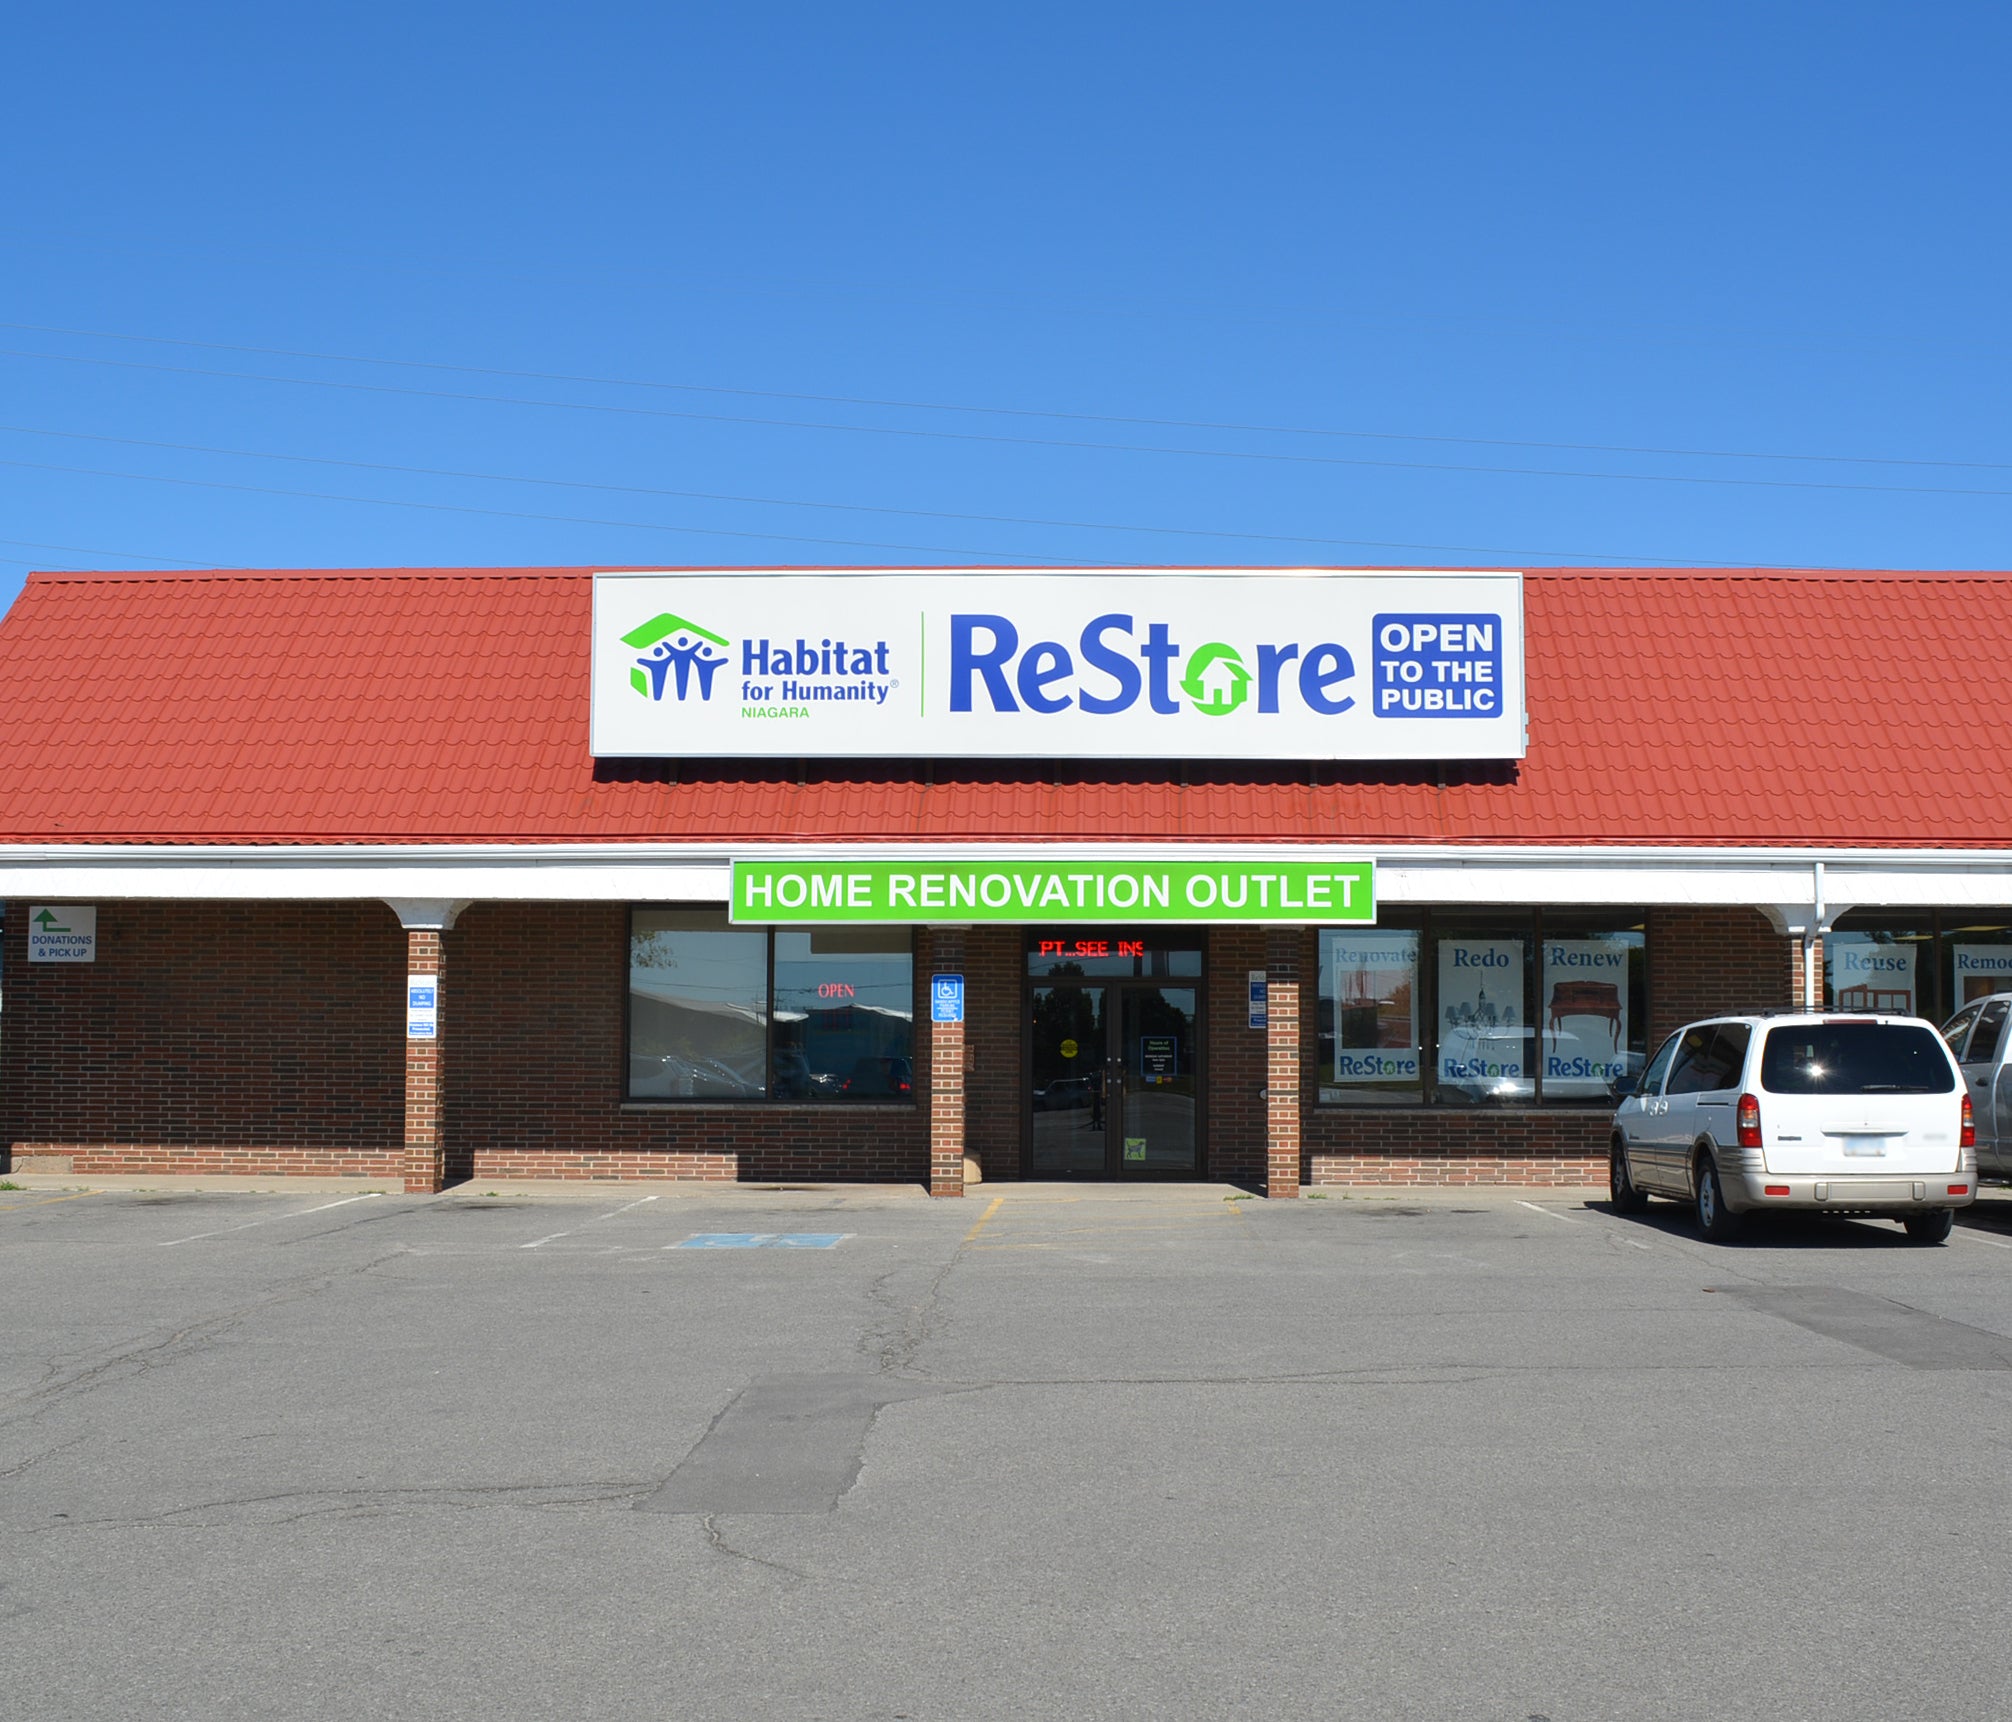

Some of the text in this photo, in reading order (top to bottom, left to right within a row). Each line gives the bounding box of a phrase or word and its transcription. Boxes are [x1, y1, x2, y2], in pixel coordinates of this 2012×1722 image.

[1380, 623, 1494, 653] OPEN
[741, 638, 889, 676] Habitat
[950, 613, 1356, 716] ReStore
[1381, 660, 1494, 683] TO THE
[741, 680, 774, 701] for
[1381, 688, 1495, 711] PUBLIC
[741, 707, 809, 718] NIAGARA
[745, 873, 1361, 909] HOME RENOVATION OUTLET
[32, 935, 92, 945] DONATIONS
[38, 948, 87, 957] & PICK UP
[1336, 947, 1417, 963] Renovate
[1453, 948, 1509, 968] Redo
[1551, 947, 1623, 968] Renew
[1844, 951, 1907, 971] Reuse
[818, 983, 855, 998] OPEN
[1340, 1055, 1416, 1075] ReStore
[1444, 1058, 1520, 1078] ReStore
[1548, 1057, 1623, 1077] ReStore
